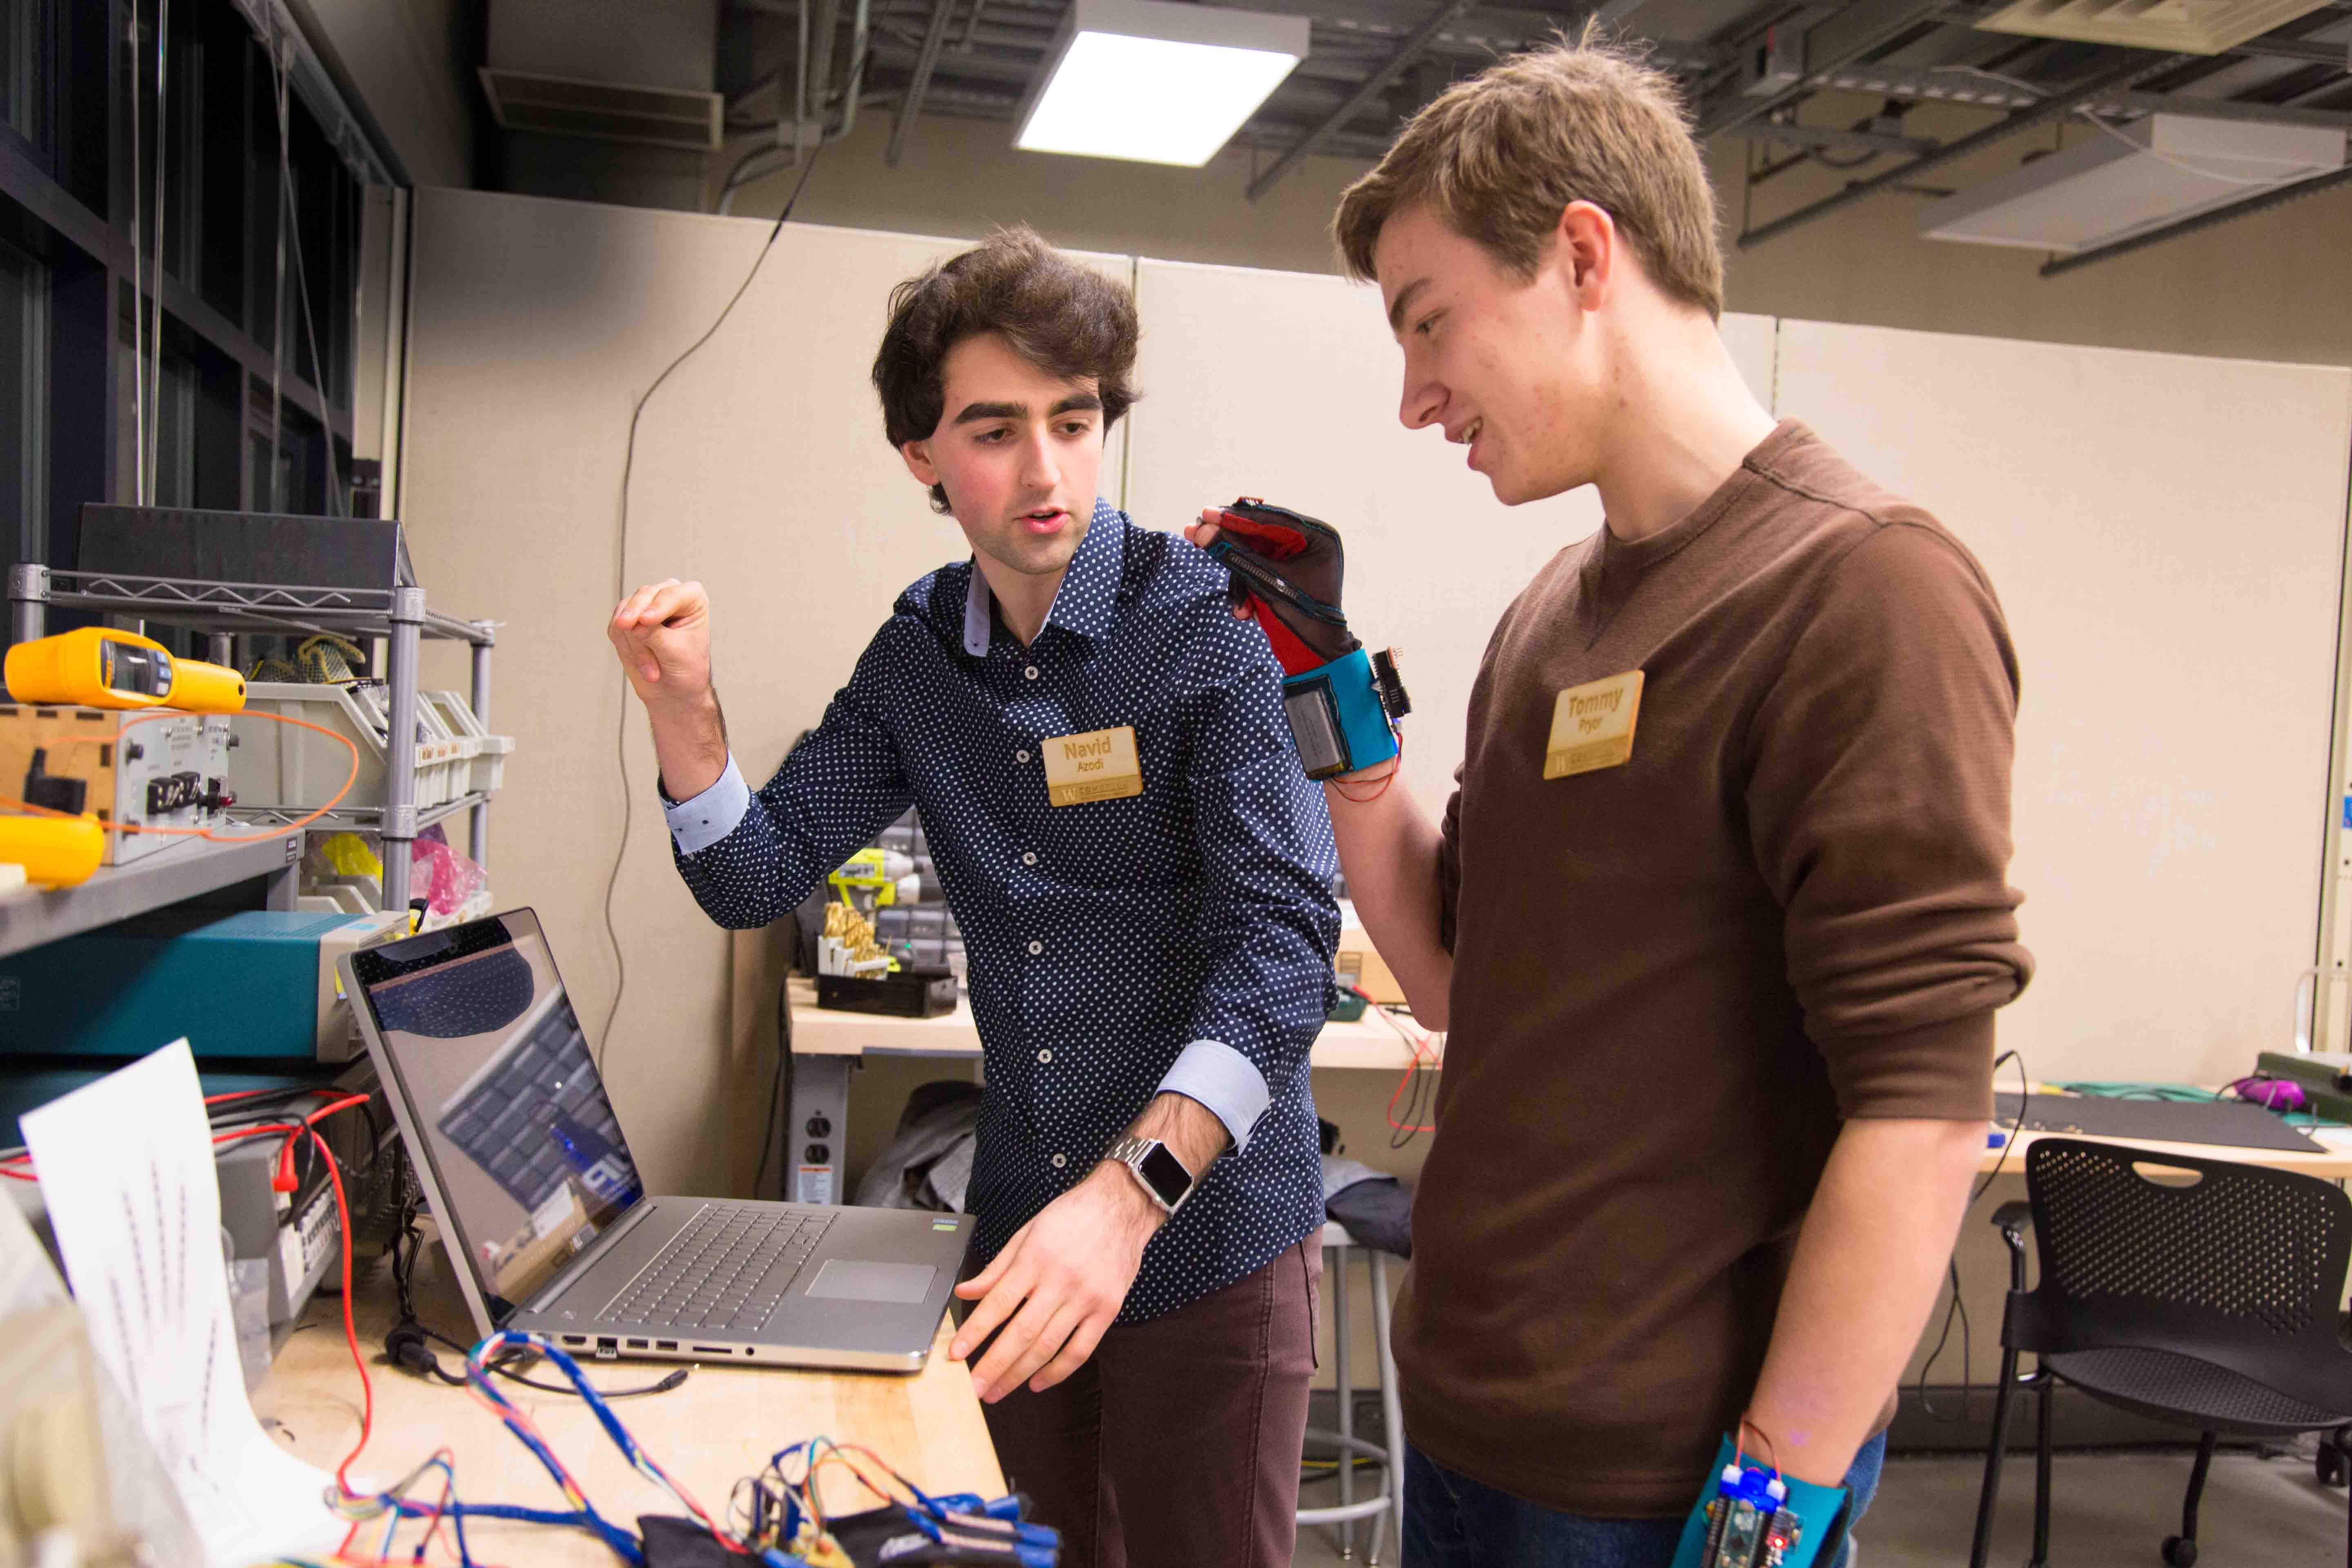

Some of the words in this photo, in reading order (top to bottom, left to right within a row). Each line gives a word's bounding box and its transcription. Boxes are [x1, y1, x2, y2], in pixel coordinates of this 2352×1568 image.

[1569, 688, 1624, 719] Tommy
[1063, 736, 1111, 760] Navid
[1078, 758, 1104, 772] Azodi
